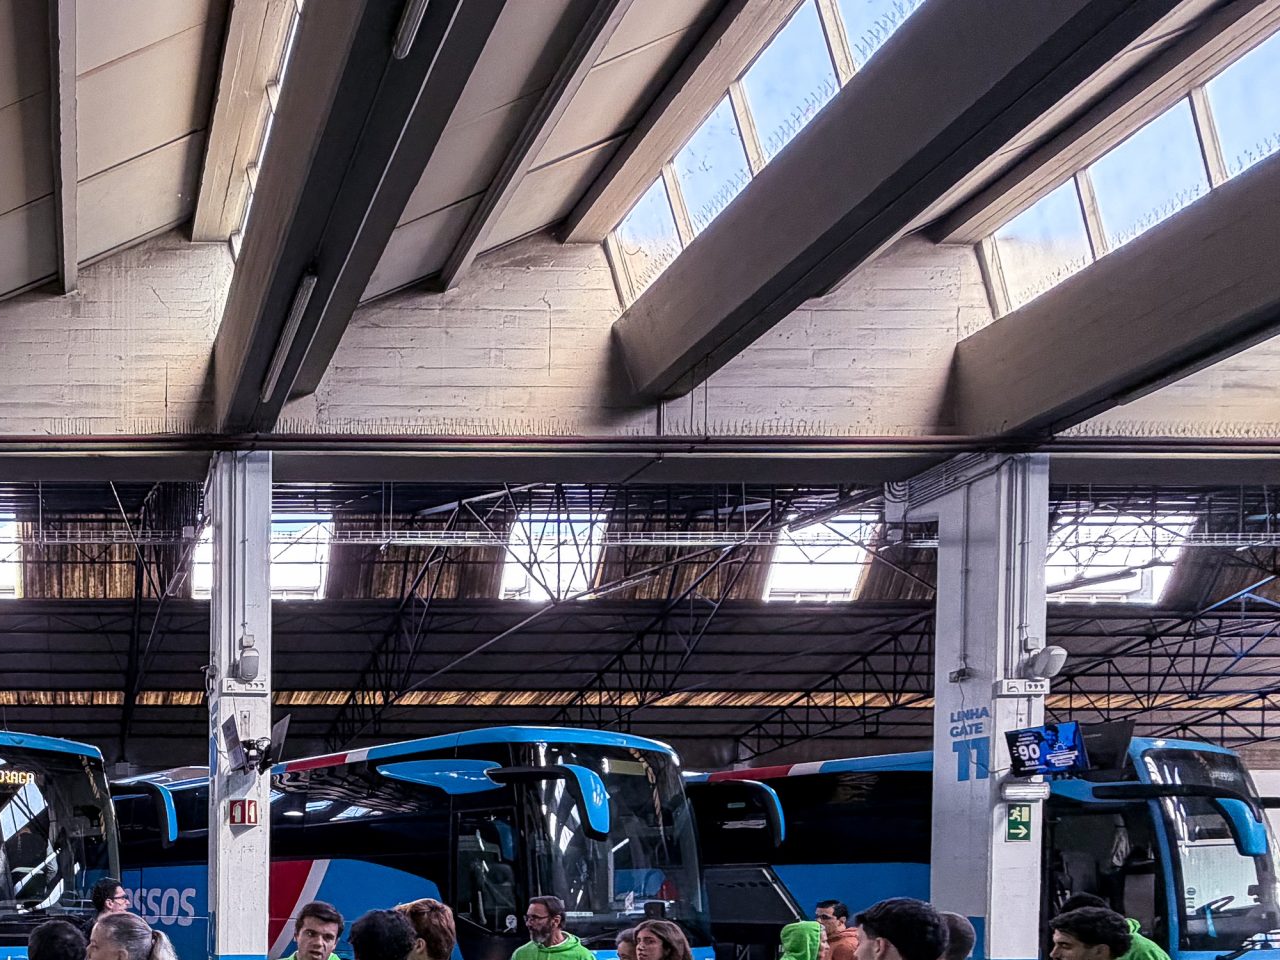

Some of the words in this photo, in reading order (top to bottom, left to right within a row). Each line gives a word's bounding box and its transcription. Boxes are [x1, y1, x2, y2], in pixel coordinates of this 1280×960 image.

[950, 706, 990, 723] LINHA
[950, 722, 983, 738] GATE
[952, 736, 990, 782] 11
[1018, 743, 1040, 760] 90
